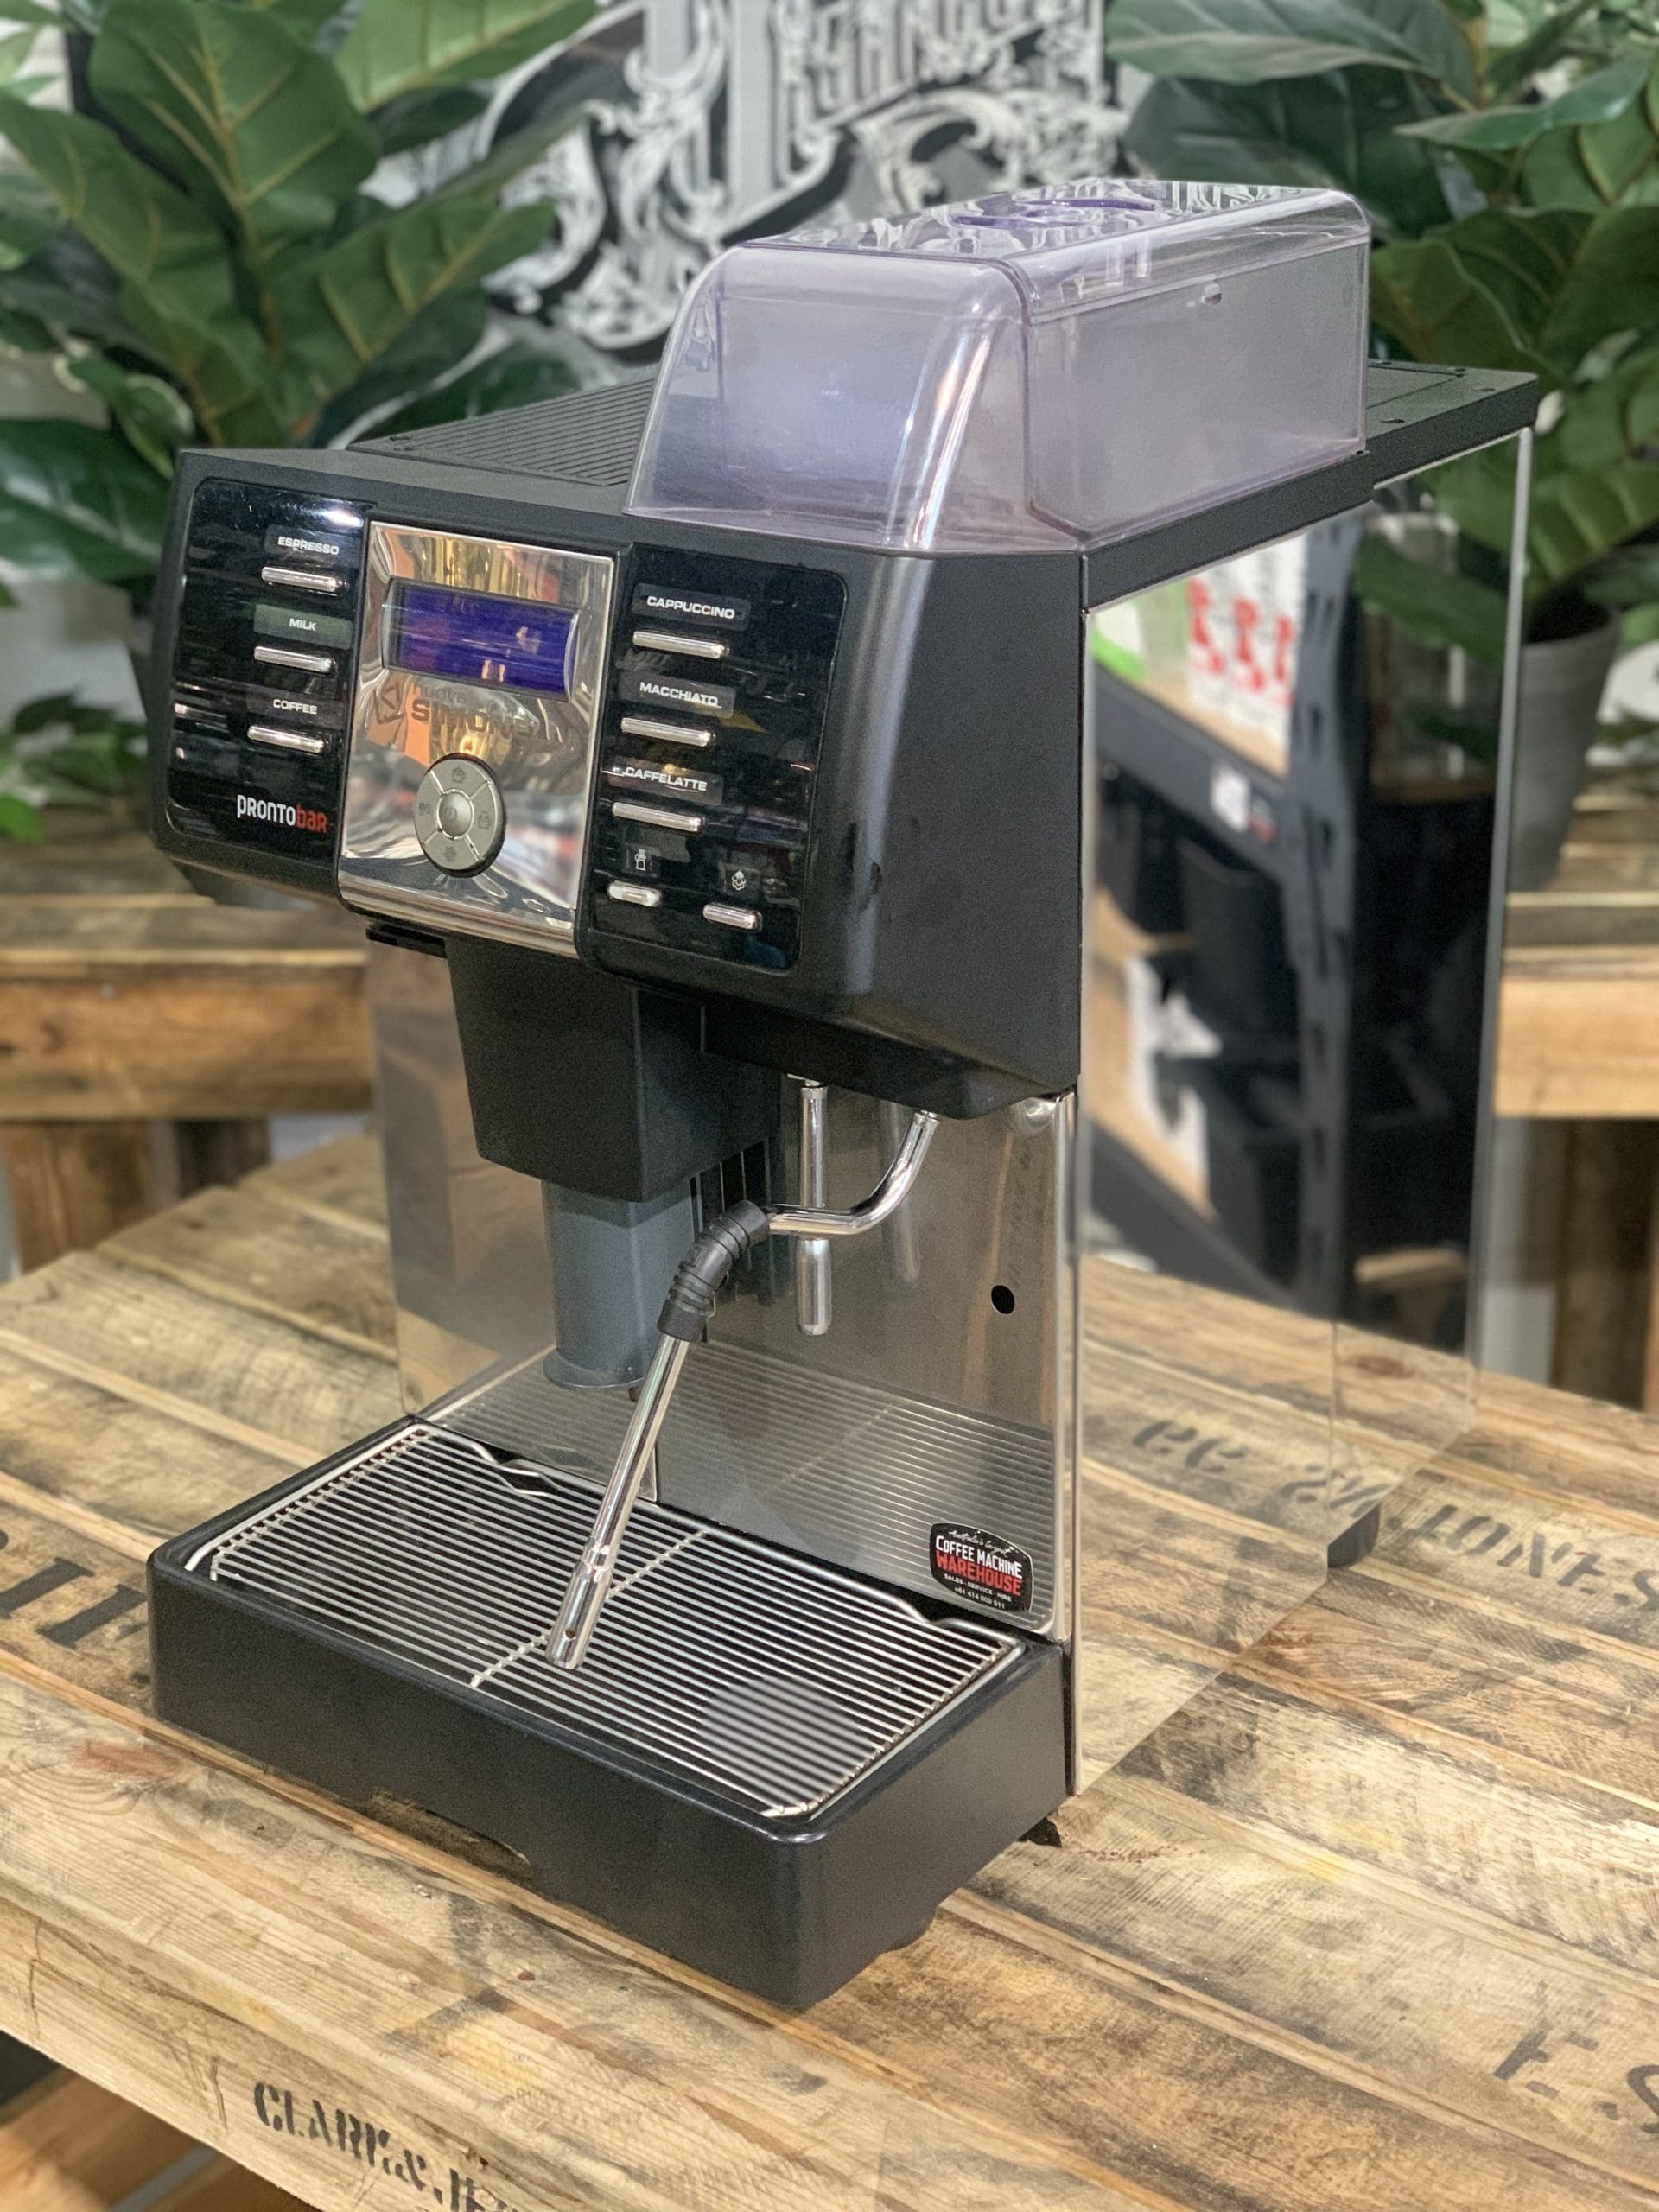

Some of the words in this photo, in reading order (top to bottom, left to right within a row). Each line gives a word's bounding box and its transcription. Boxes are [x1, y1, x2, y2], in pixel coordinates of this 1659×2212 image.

[278, 536, 340, 555] ESPRESSO
[647, 595, 735, 620] CAPPUCCINO
[289, 618, 317, 632] MILK
[639, 681, 720, 707] MACCHIATO
[273, 698, 318, 715] COFFEE
[625, 766, 708, 791] CAFFELATTE
[936, 1535, 975, 1562] COFFEE
[976, 1548, 1023, 1579] MACHINE
[936, 1550, 1023, 1597] WAREHOUSE
[944, 1573, 963, 1585] SALES
[967, 1581, 993, 1595] SERVICE
[967, 1591, 979, 1599] 414
